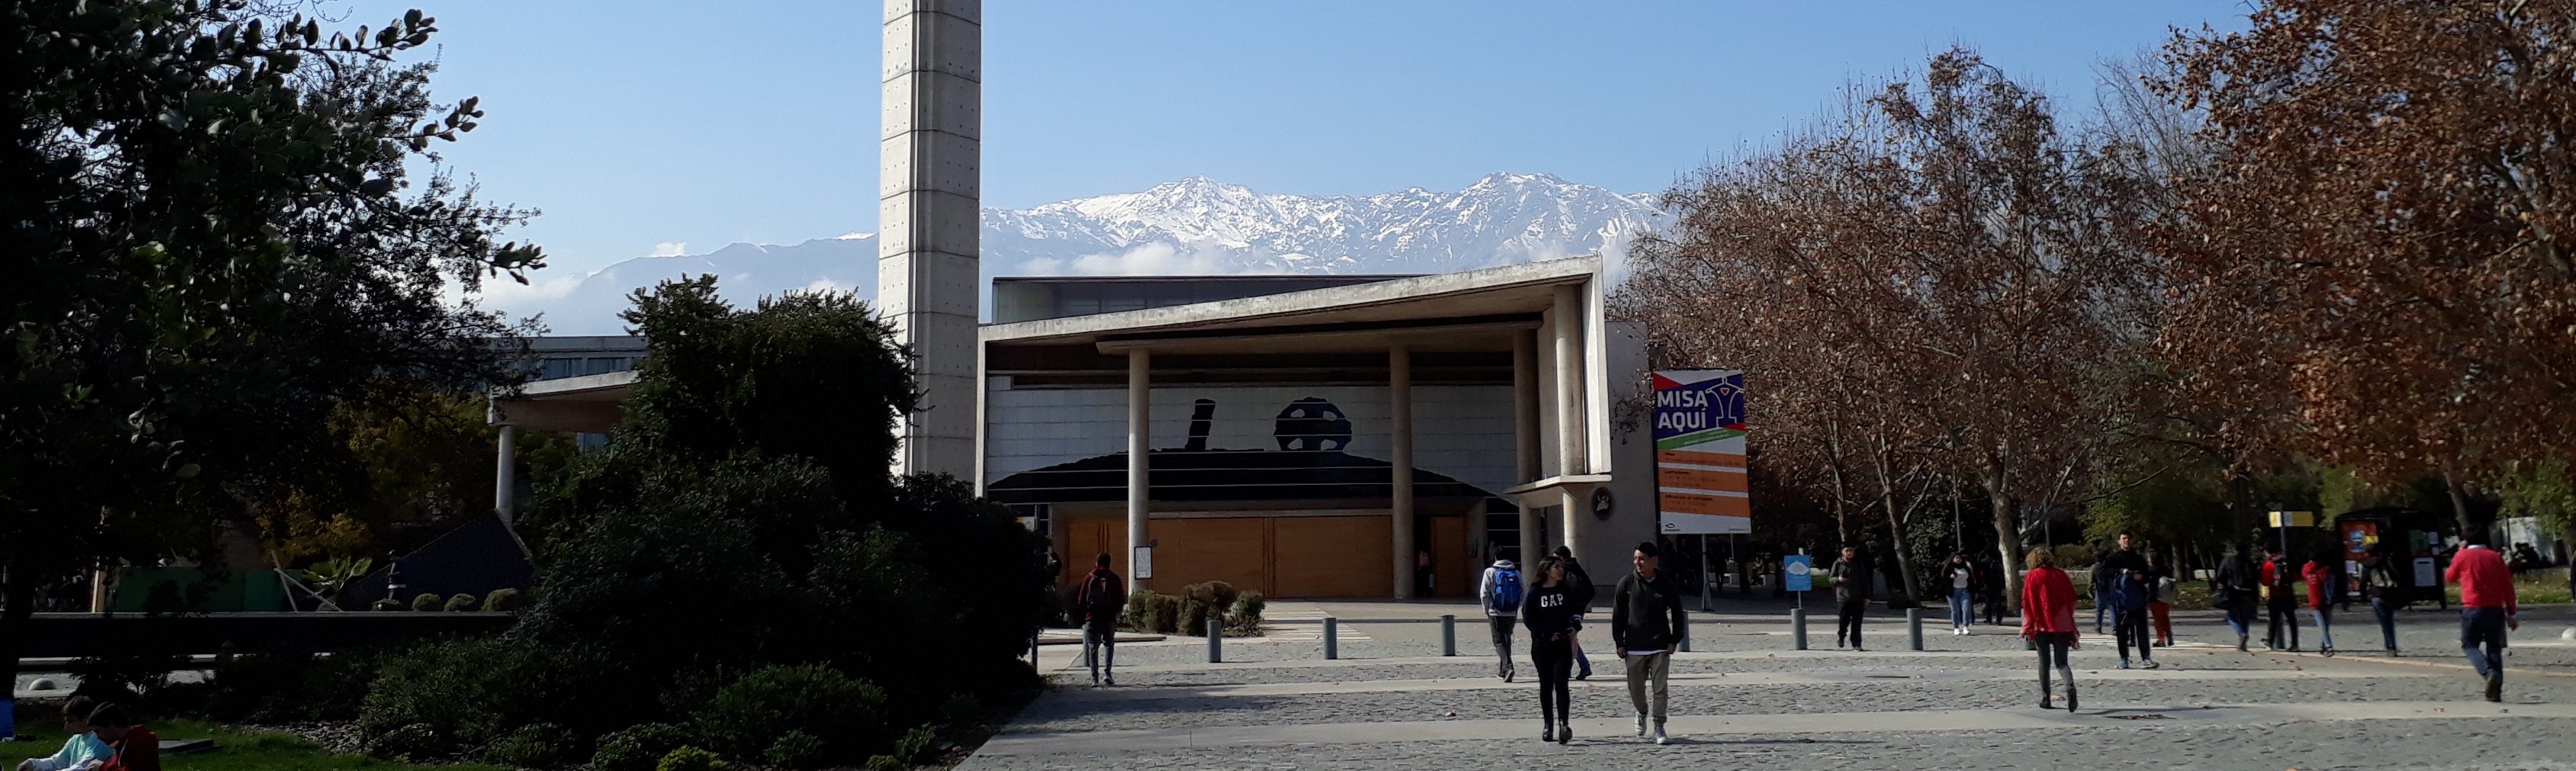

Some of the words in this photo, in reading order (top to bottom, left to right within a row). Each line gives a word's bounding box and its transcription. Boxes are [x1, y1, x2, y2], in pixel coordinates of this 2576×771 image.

[1657, 391, 1708, 407] MISA
[1658, 408, 1706, 432] AQUÍ
[1541, 594, 1564, 608] GAP
